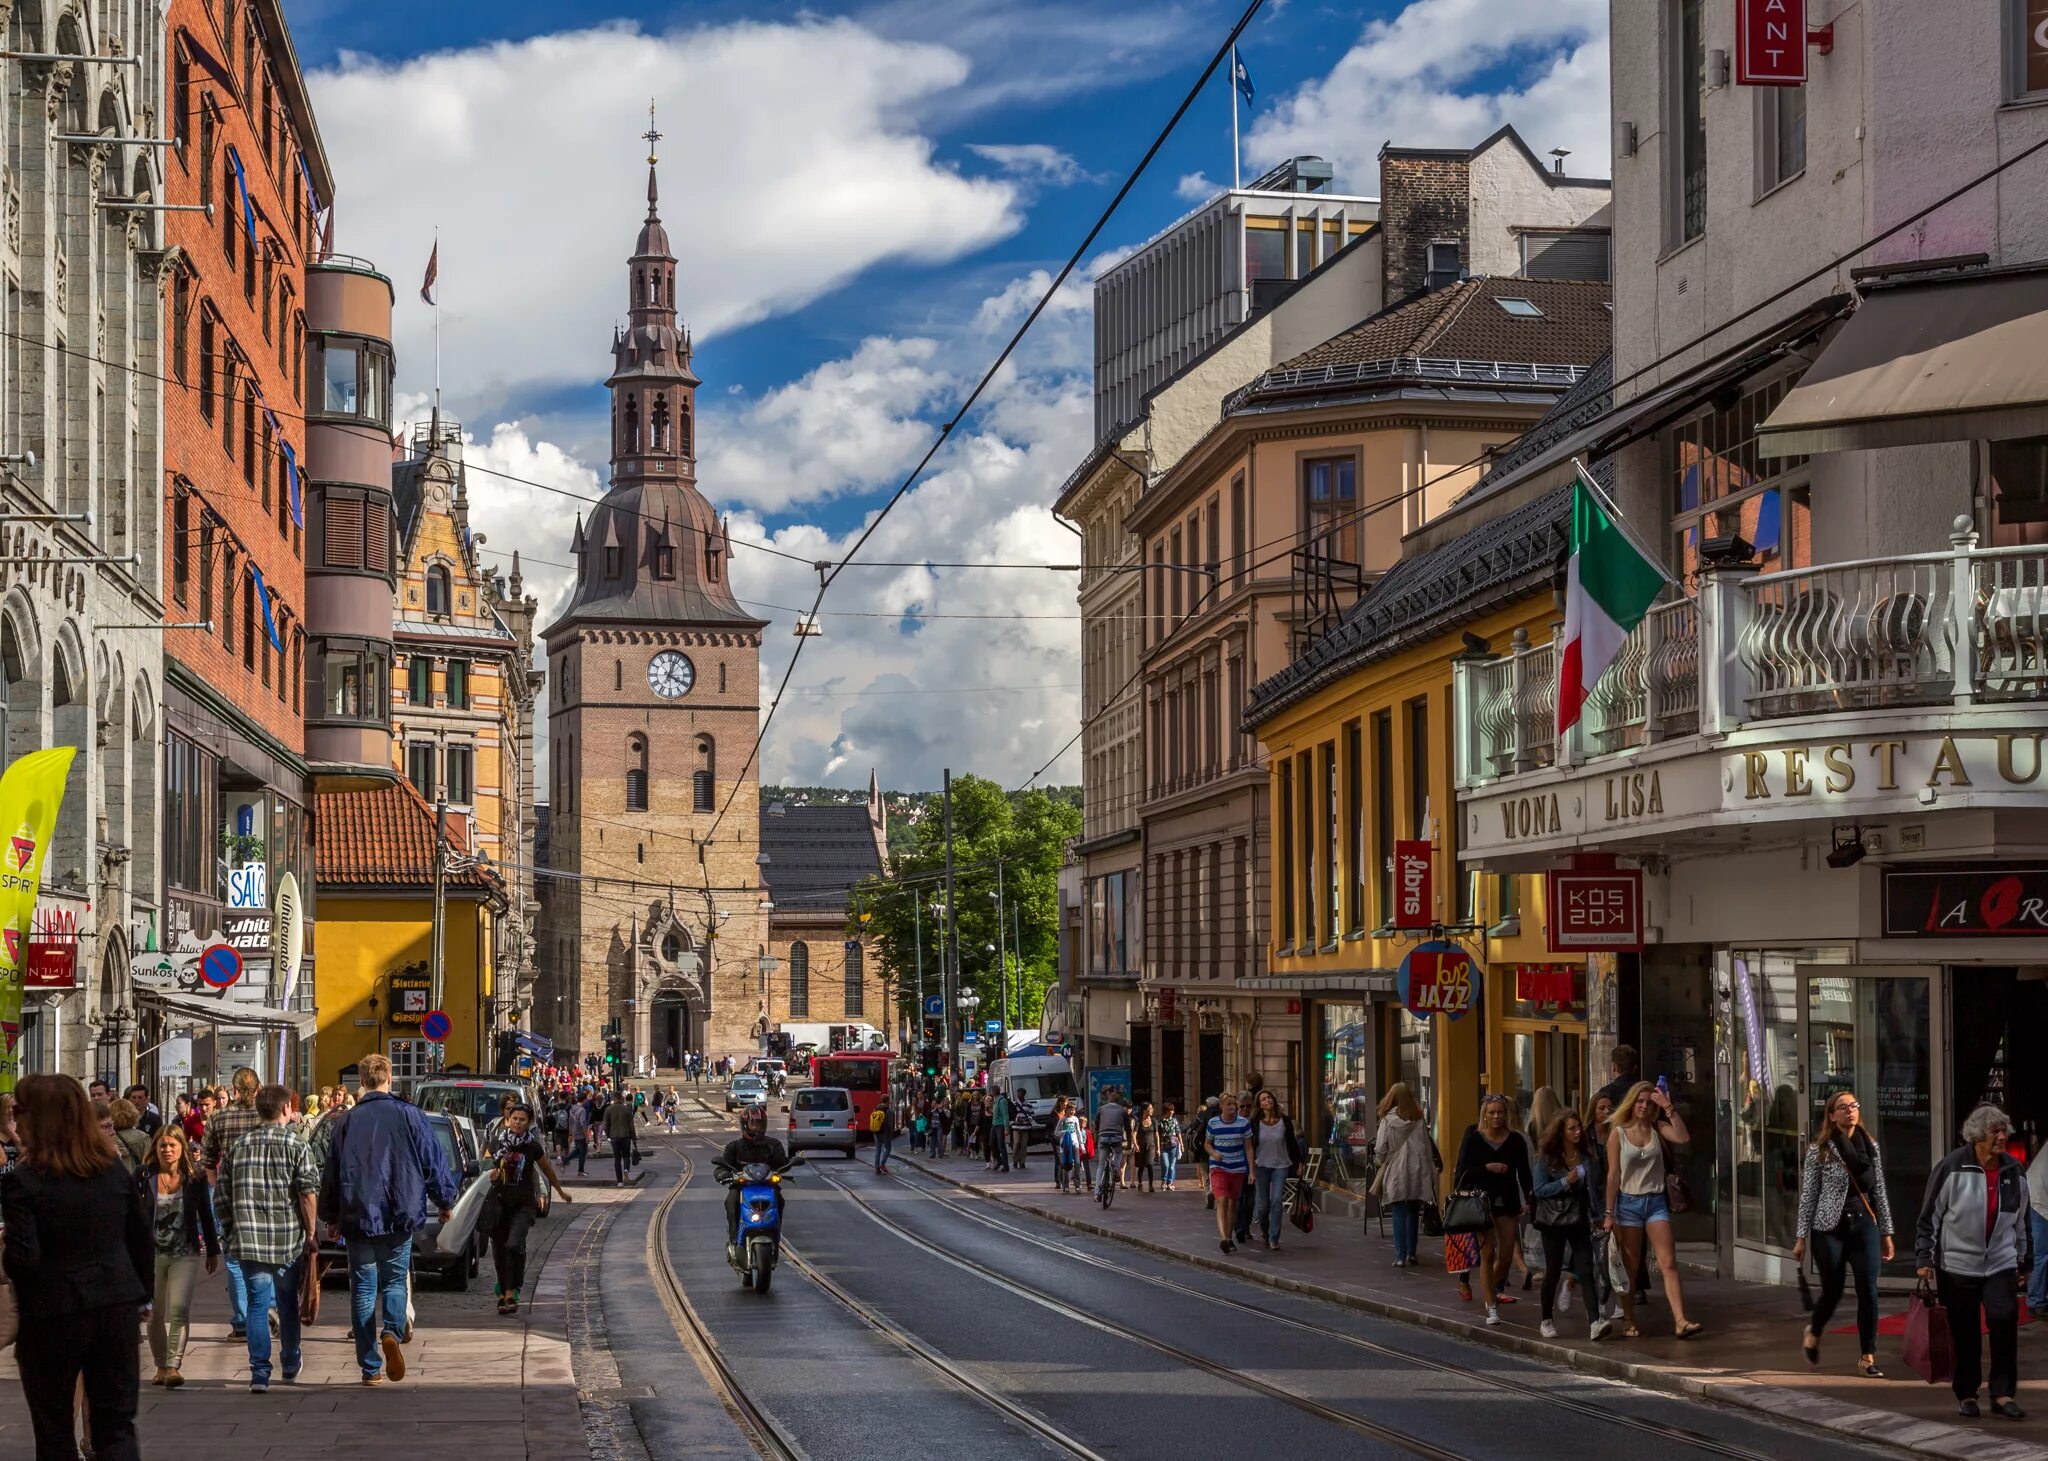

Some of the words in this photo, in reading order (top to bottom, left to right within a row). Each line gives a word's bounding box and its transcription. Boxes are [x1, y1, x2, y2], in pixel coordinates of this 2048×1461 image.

[1743, 733, 2044, 800] RESTAU
[1604, 769, 1664, 821] LISA
[131, 964, 178, 980] Sunkost
[1417, 984, 1469, 1010] JAZZ
[161, 1064, 190, 1072] sunkost
